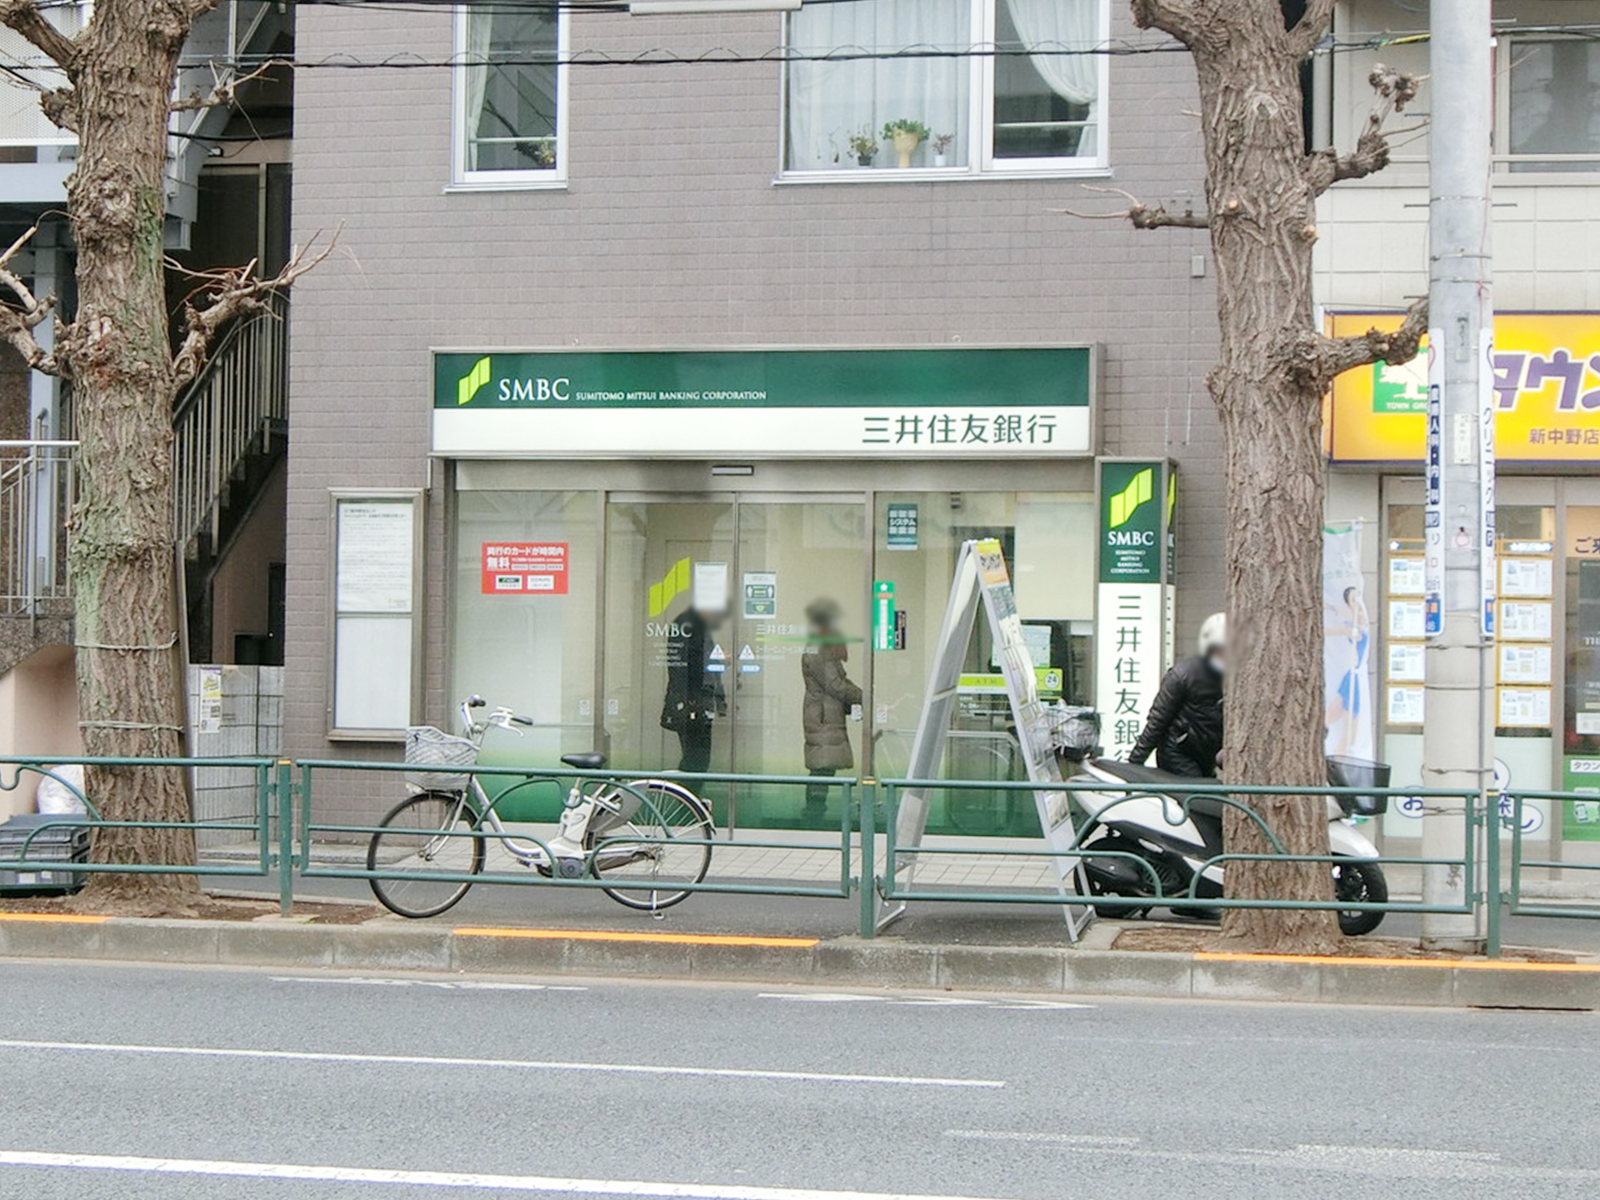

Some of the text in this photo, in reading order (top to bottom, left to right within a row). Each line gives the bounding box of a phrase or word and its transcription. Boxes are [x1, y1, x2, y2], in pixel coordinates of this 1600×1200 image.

[498, 378, 767, 401] SMBC SUMITOMO MITSUI BANKING CORPORATION
[861, 414, 1057, 444] 三井住友銀行
[1530, 428, 1599, 445] 新中野店
[1107, 531, 1154, 546] SMBC
[645, 622, 692, 637] SMBC
